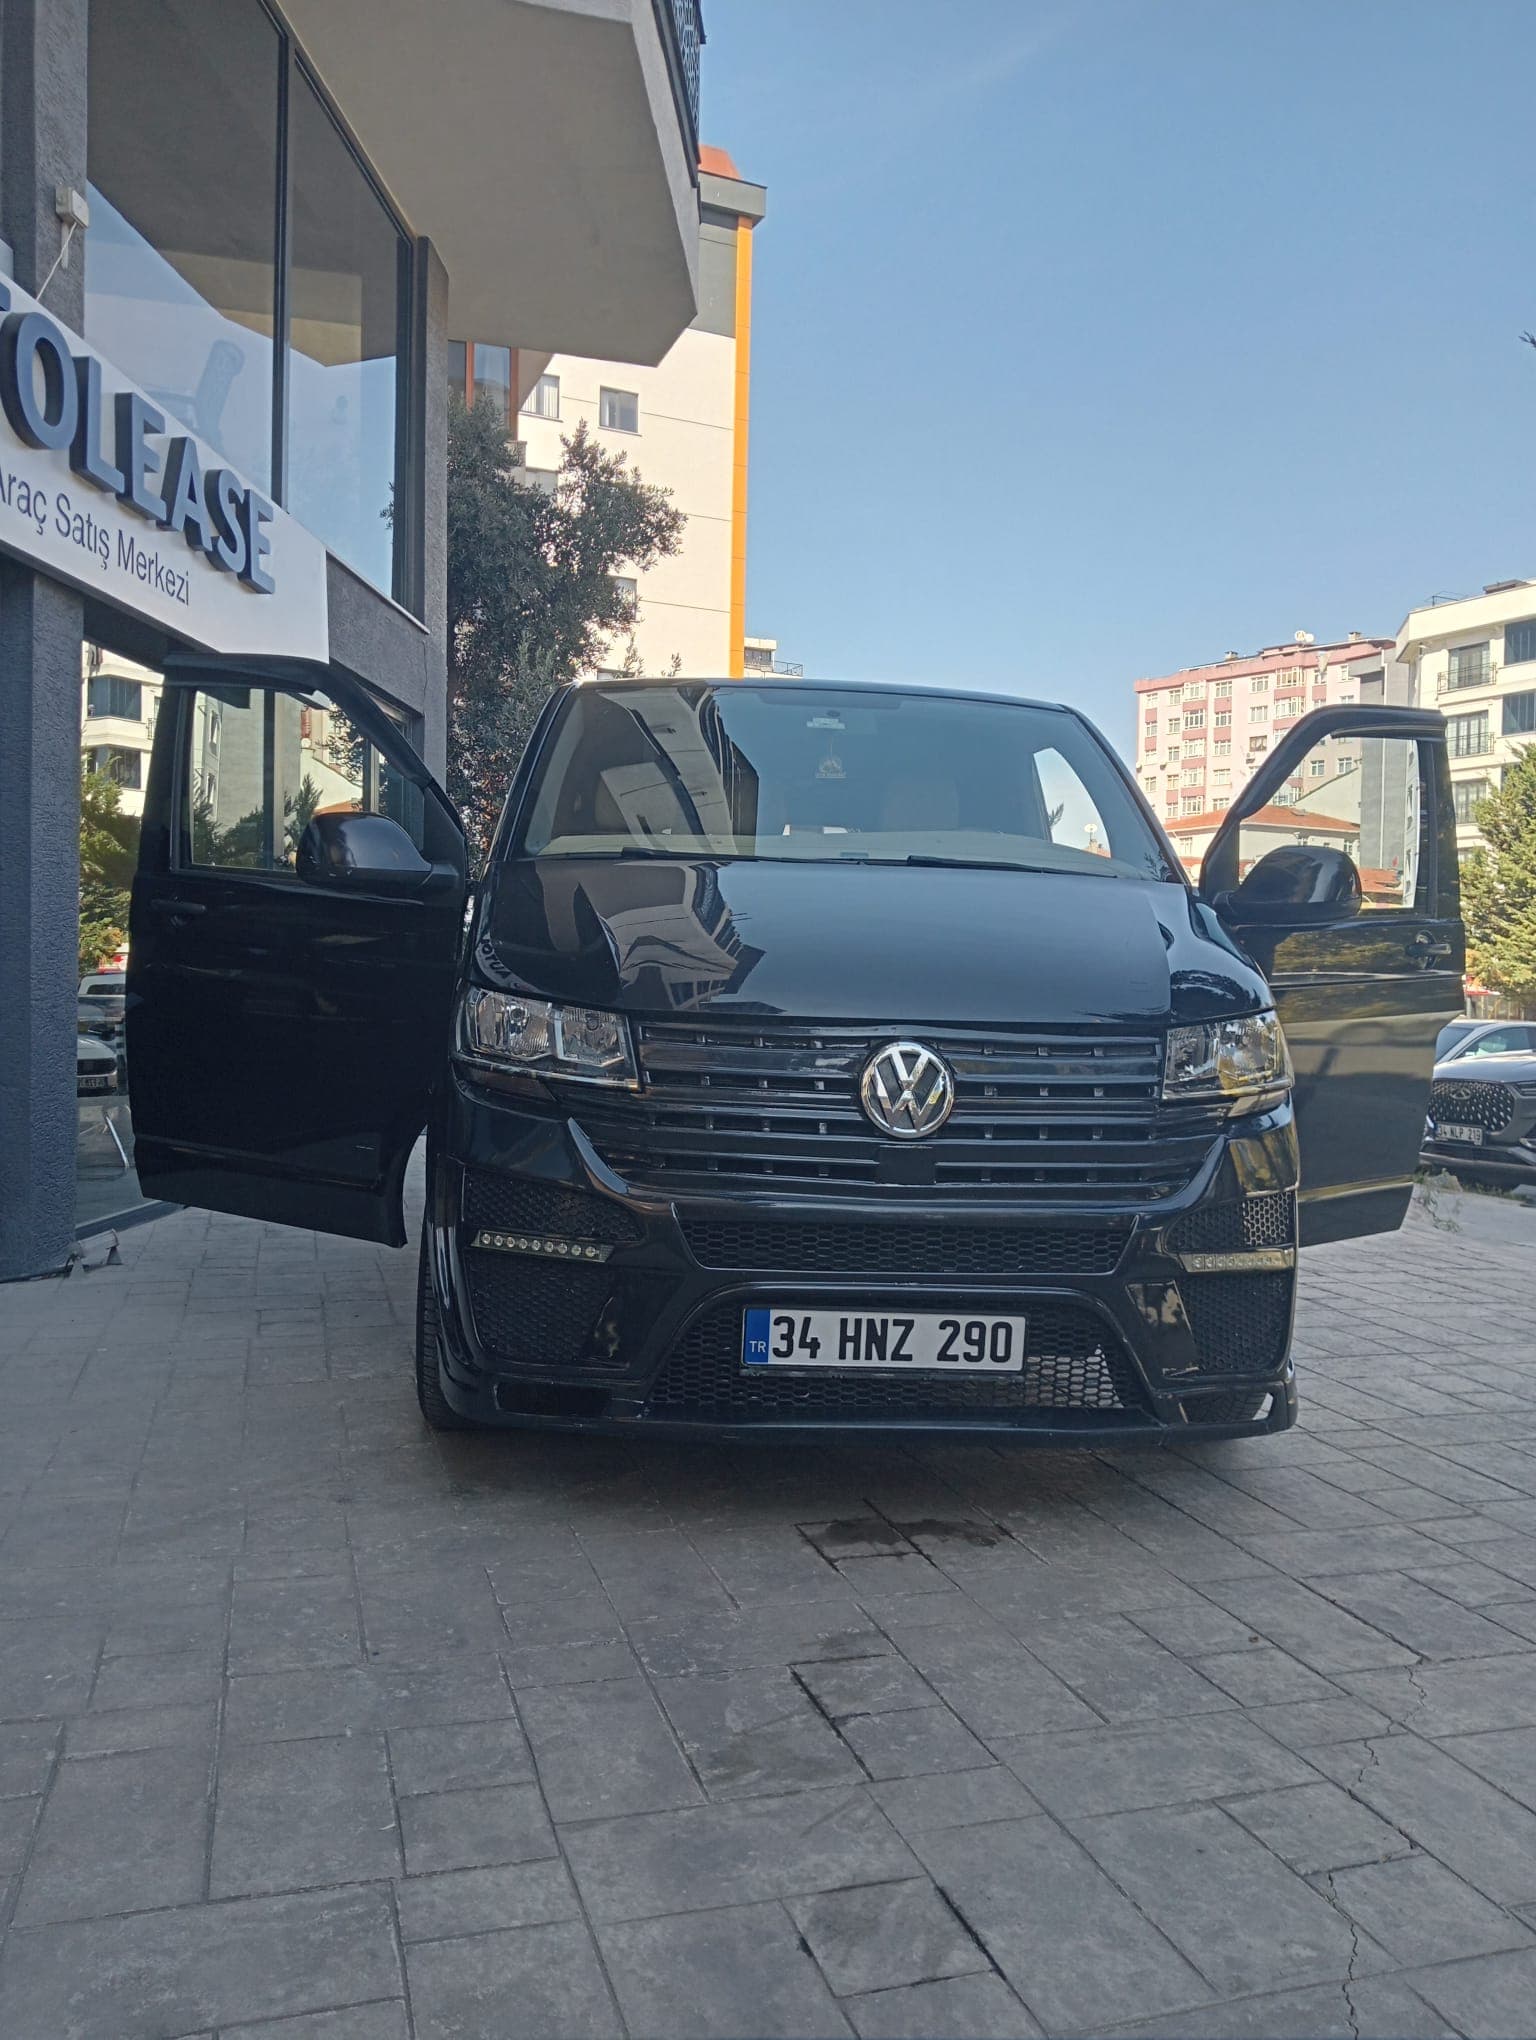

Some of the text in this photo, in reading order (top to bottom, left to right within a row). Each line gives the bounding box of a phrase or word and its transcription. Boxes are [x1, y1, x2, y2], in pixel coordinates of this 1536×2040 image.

[55, 492, 110, 570] Satış
[117, 529, 190, 606] Merkezi
[749, 1316, 1012, 1363] TR 34 HNZ 290
